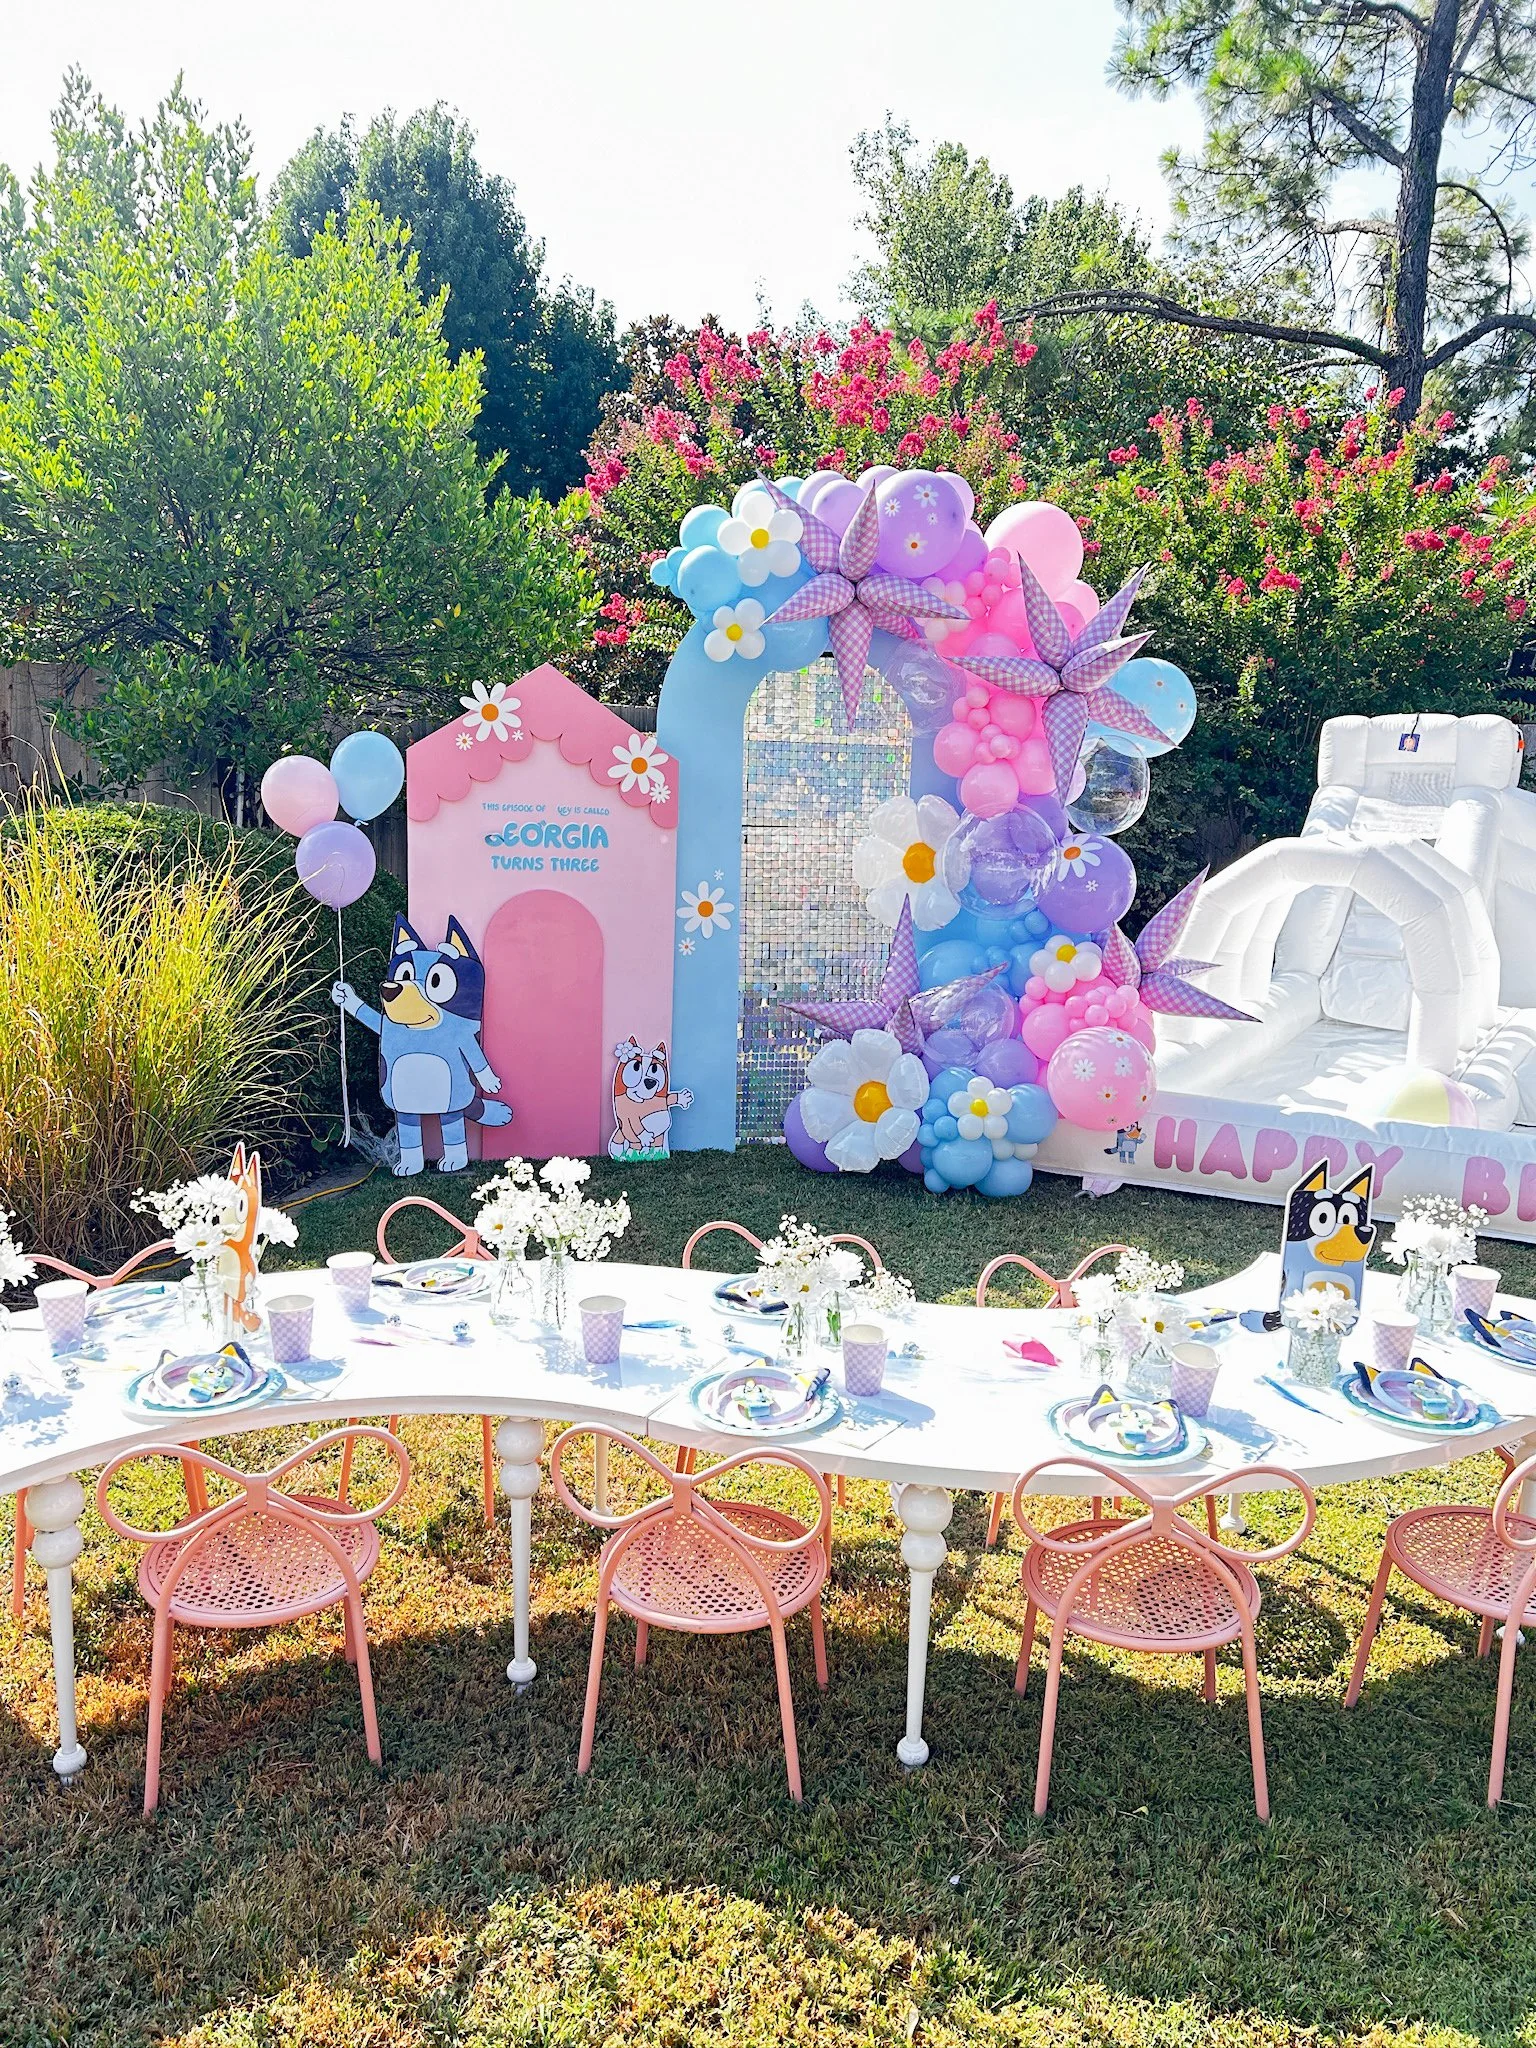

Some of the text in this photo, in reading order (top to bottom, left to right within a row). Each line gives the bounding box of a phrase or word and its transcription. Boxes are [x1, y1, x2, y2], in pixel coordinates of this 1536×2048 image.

[482, 802, 500, 811] THIS
[501, 803, 533, 812] EPISODE
[535, 804, 546, 812] OF
[574, 806, 581, 814] IS
[583, 807, 610, 816] CALLED
[491, 855, 600, 872] TURNS THREE
[1153, 1115, 1404, 1200] HAPPY
